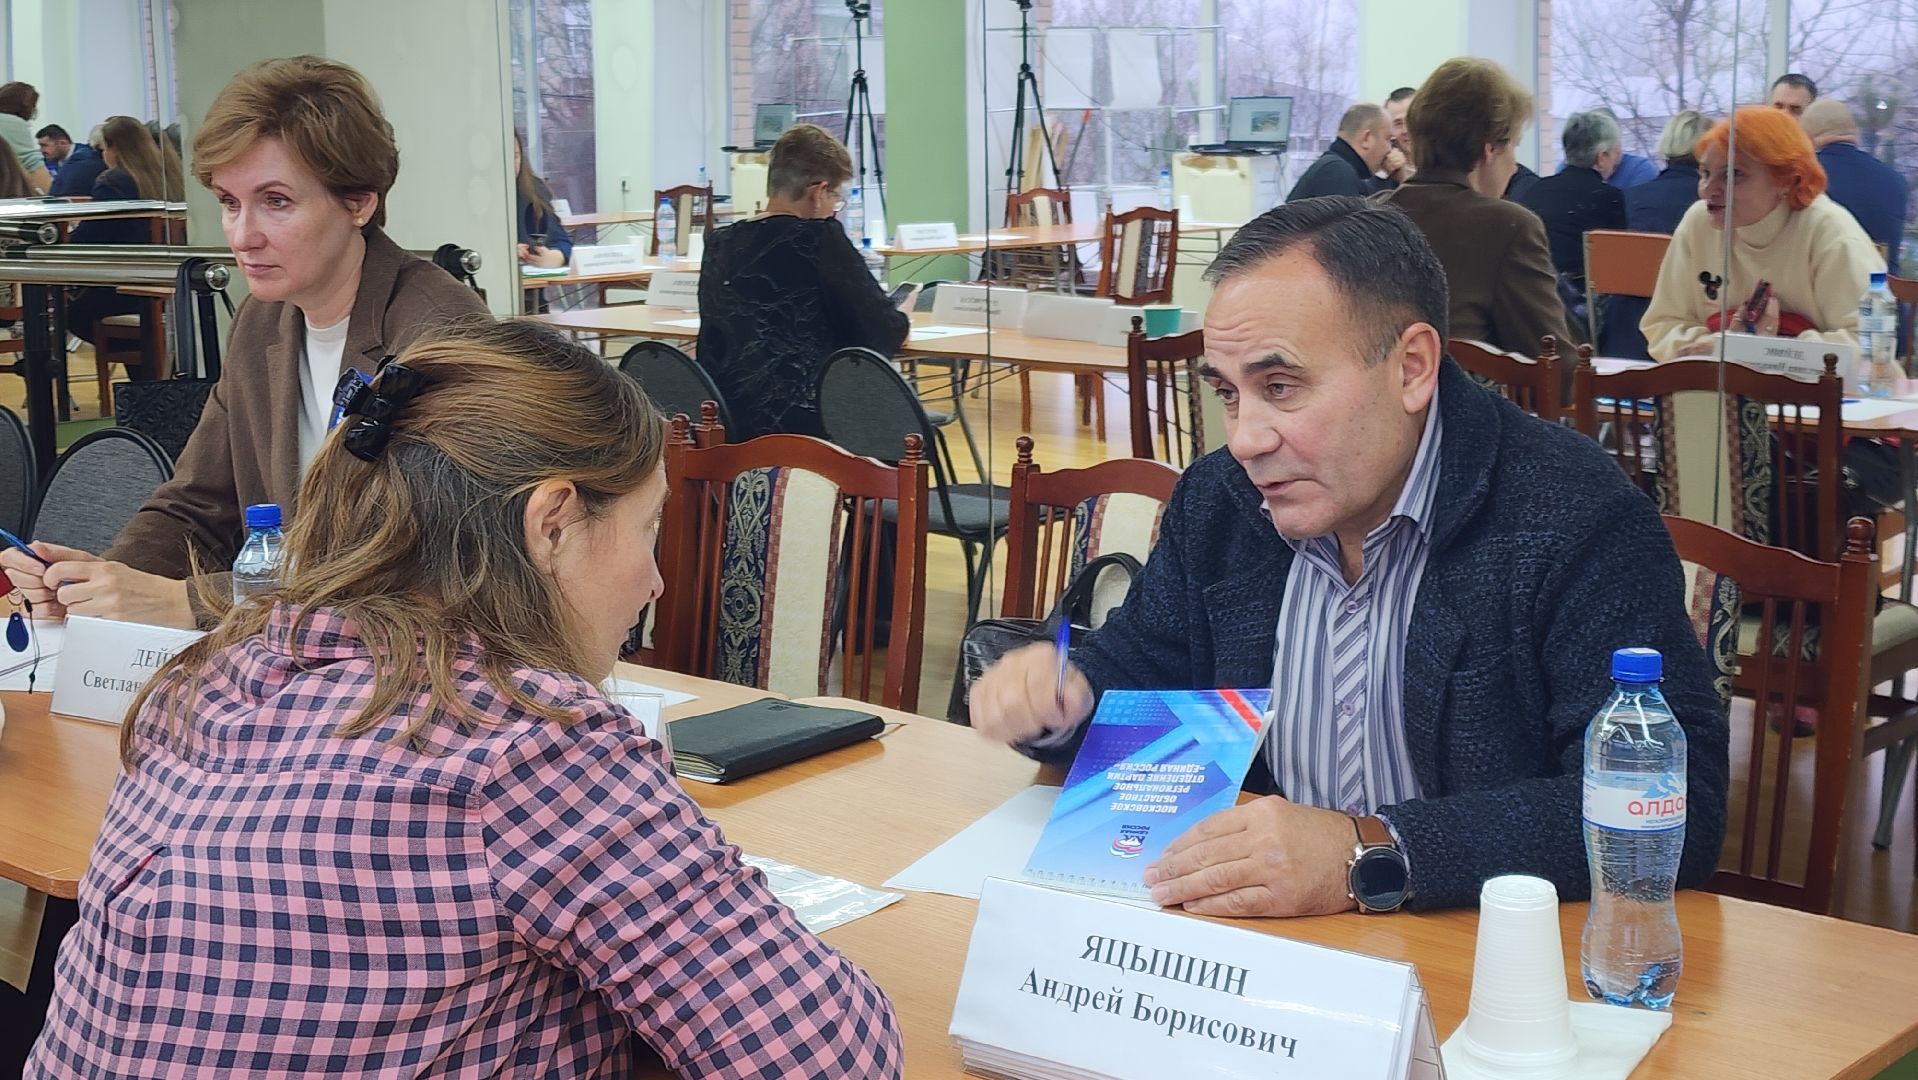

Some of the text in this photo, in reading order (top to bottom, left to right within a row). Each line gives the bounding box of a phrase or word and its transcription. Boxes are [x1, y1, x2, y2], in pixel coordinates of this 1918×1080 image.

[131, 648, 175, 669] ДЕЙ
[1107, 772, 1205, 784] ОТДЕЛЕНИЕ ПАРТИИ
[1113, 782, 1191, 794] РЕГИОНАЛЬНОЕ
[1119, 792, 1178, 803] ОБЛАСТНОЕ
[1110, 802, 1178, 813] МОСКОВСКОЕ
[1079, 935, 1251, 998] ЯЦЫШИН
[1018, 967, 1298, 1059] Андрей Борисович
